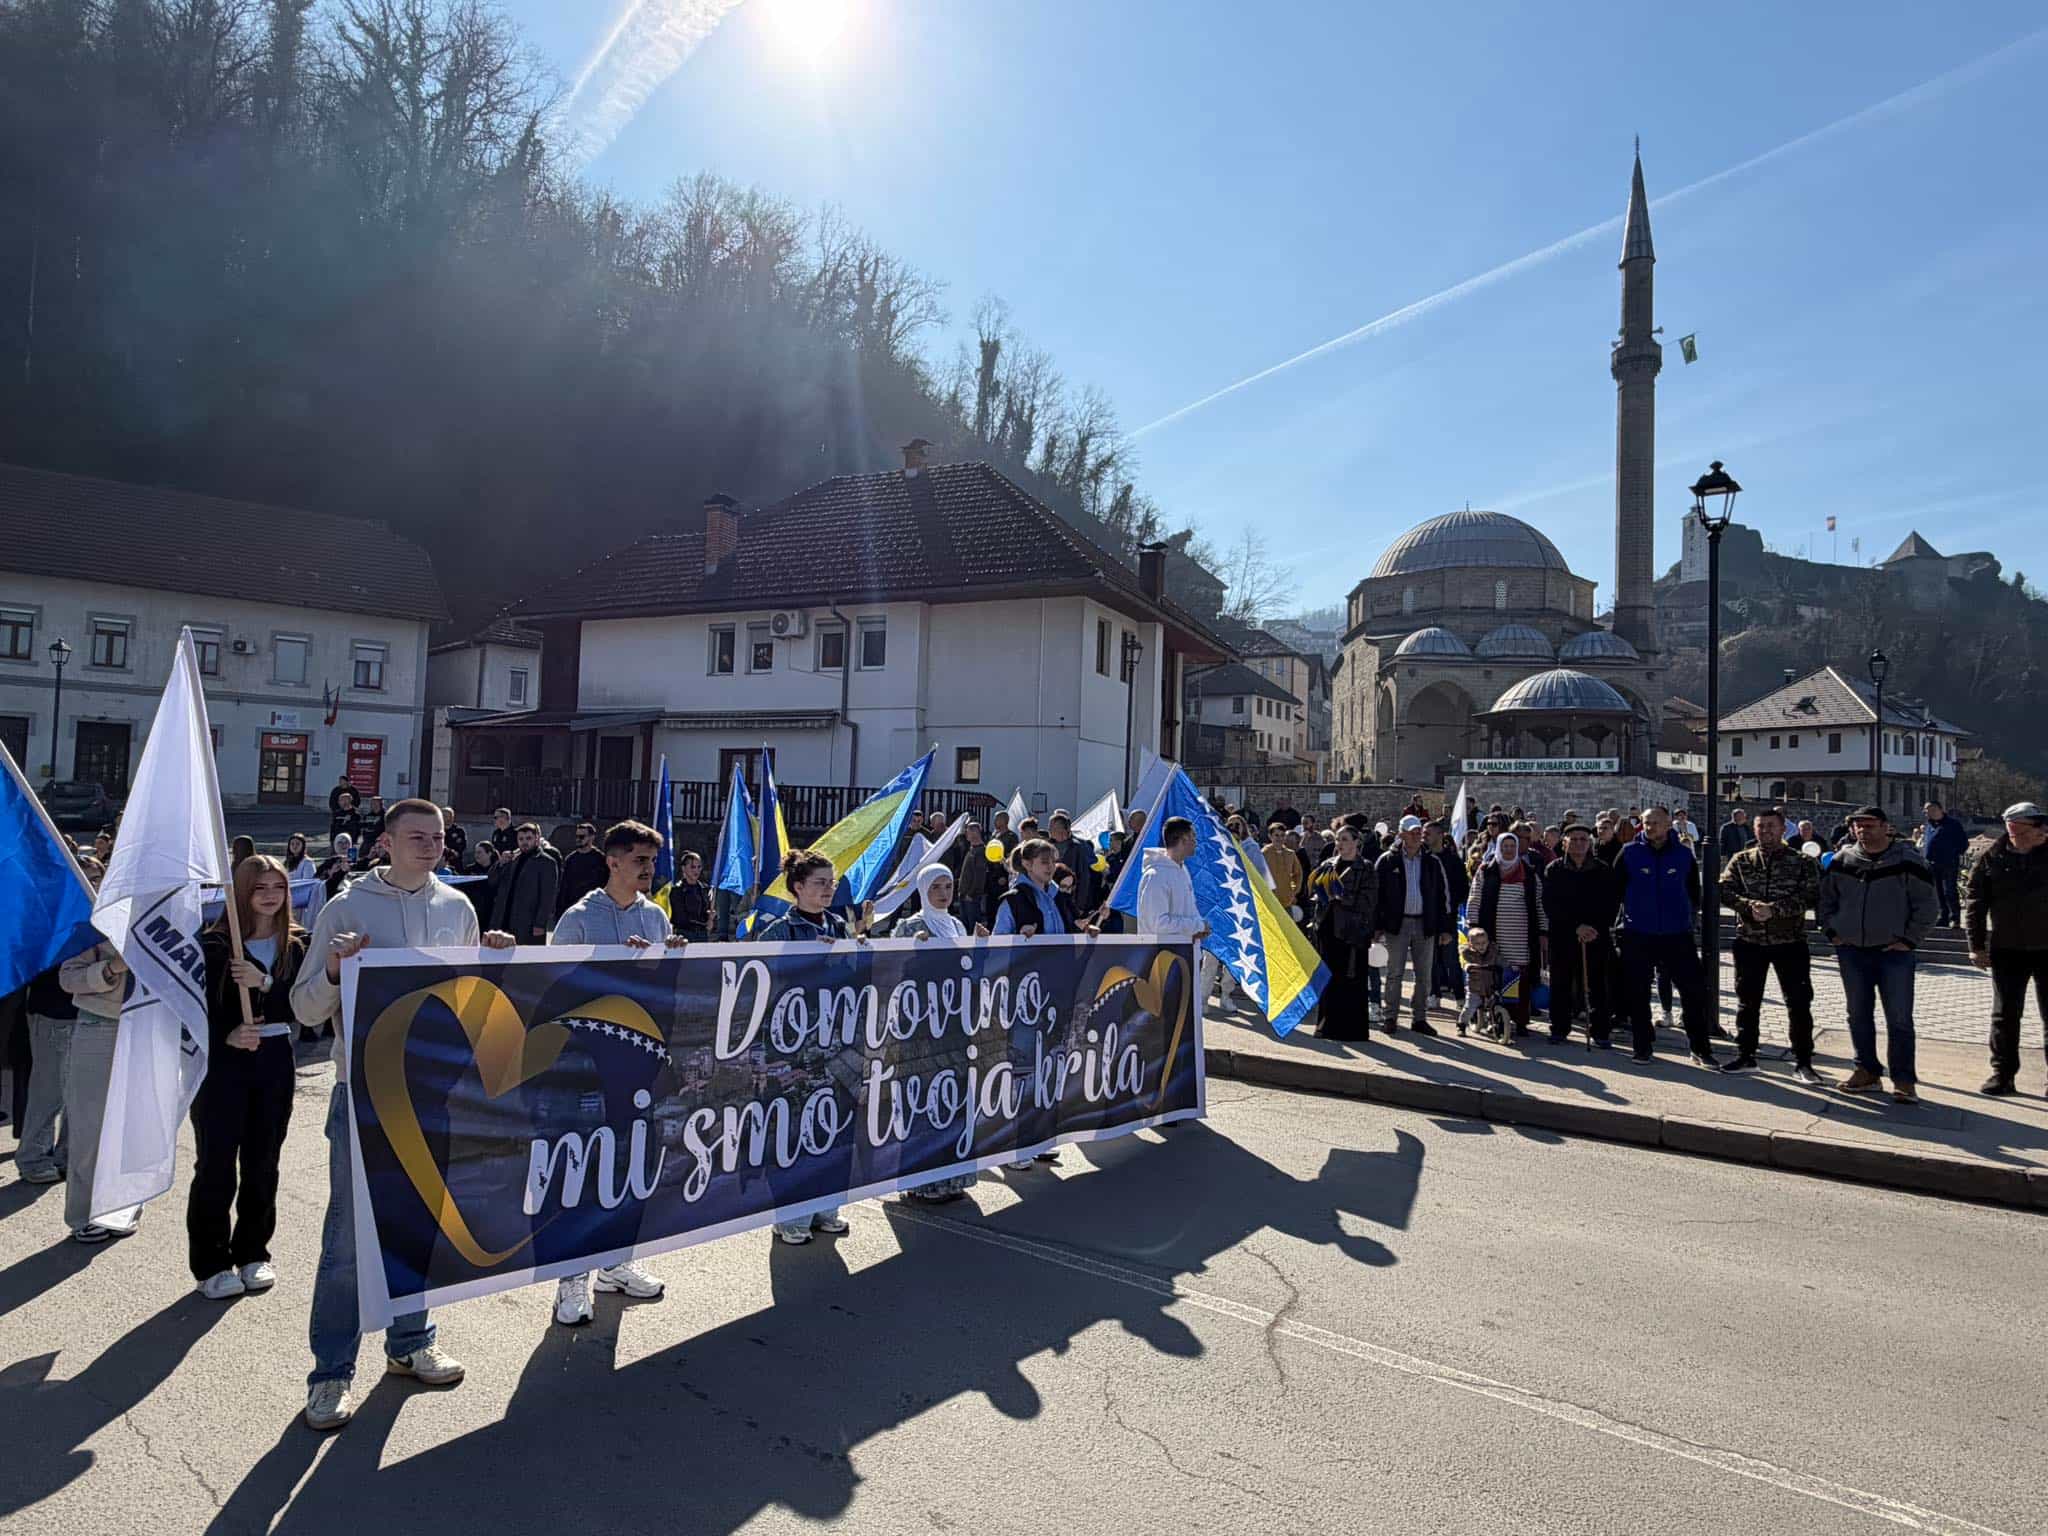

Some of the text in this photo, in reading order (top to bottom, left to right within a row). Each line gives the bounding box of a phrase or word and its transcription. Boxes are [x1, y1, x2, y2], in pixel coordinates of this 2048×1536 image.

[715, 955, 1057, 1061] Domovino,
[522, 1022, 1145, 1215] mi smo tvoja krila
